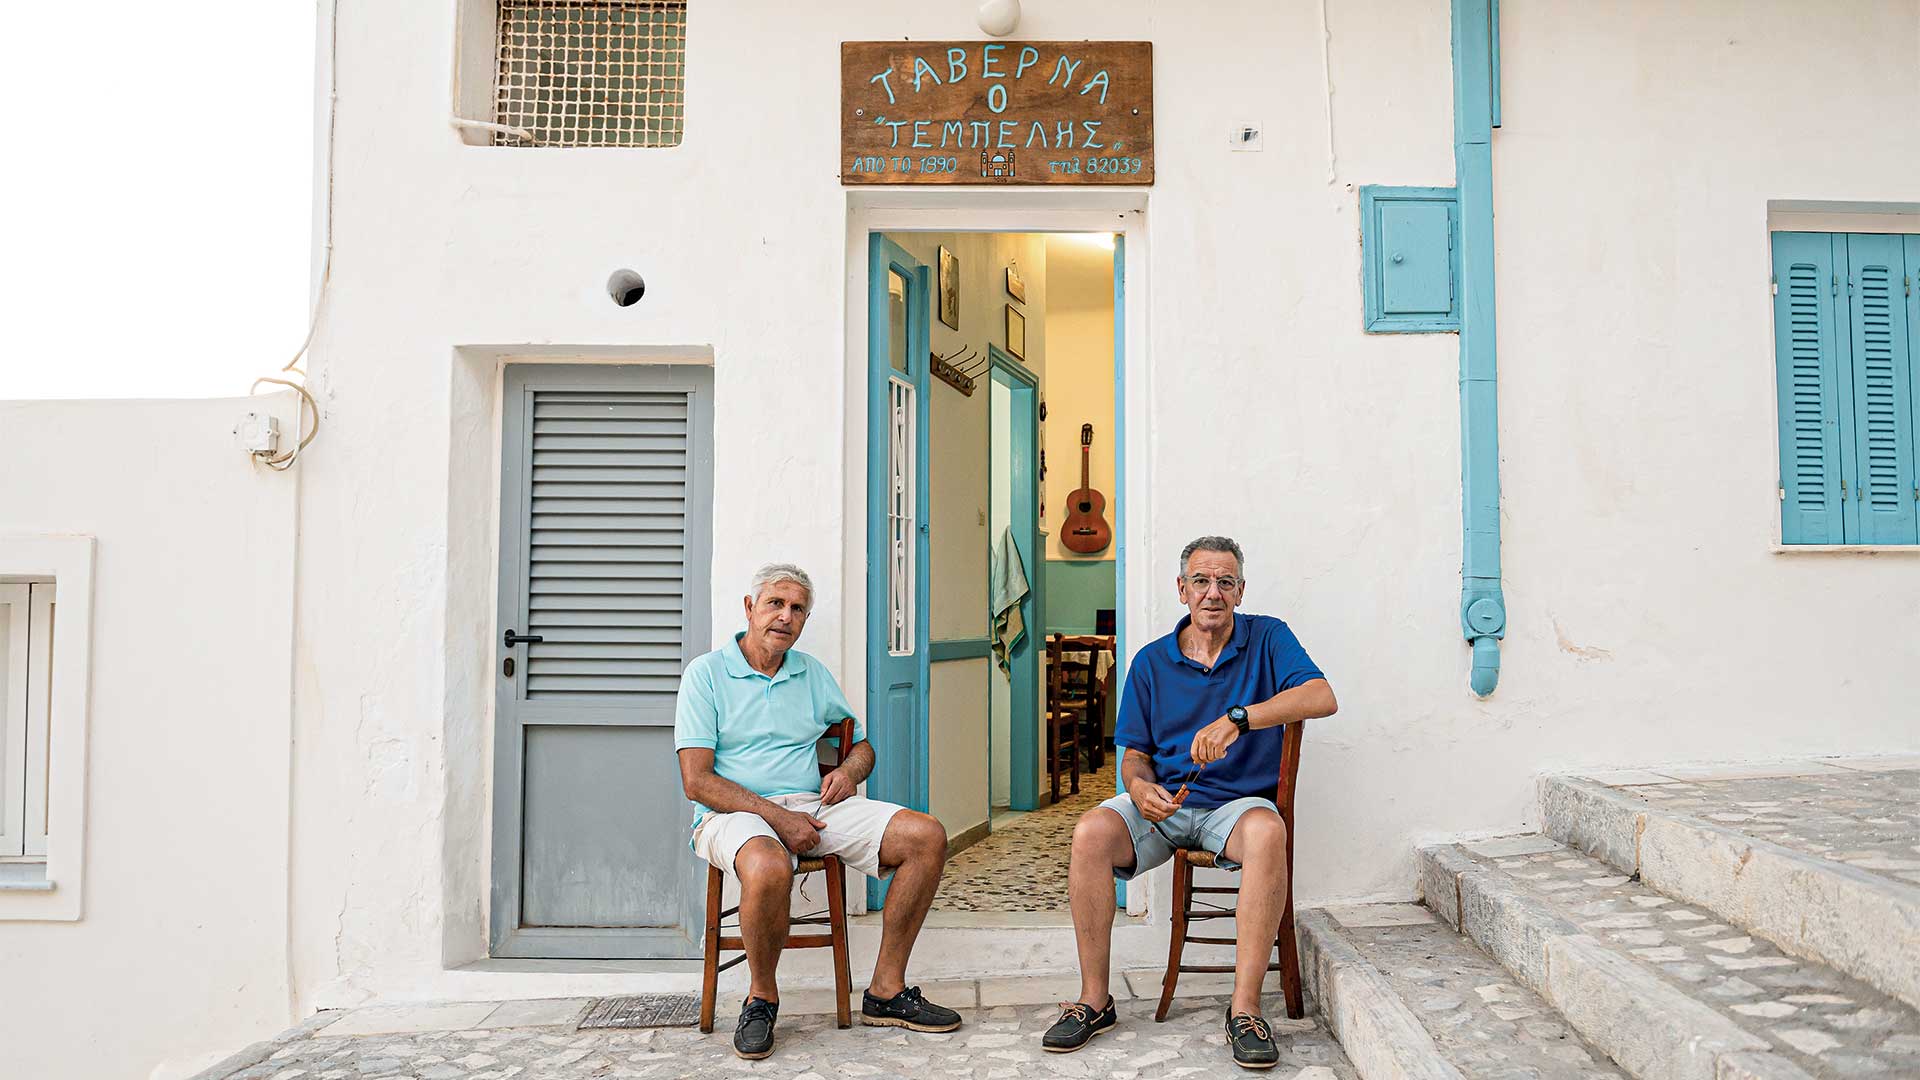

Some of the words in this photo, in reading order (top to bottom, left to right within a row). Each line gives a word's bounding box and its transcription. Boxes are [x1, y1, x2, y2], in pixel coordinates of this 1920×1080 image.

[870, 44, 1110, 105] ΤΑΒΕΡΝΑ
[986, 83, 1008, 114] Ο
[851, 156, 886, 173] ΑΠΟ
[891, 156, 912, 173] ΤΟ
[919, 155, 957, 173] 1890
[1085, 156, 1142, 174] 82039
